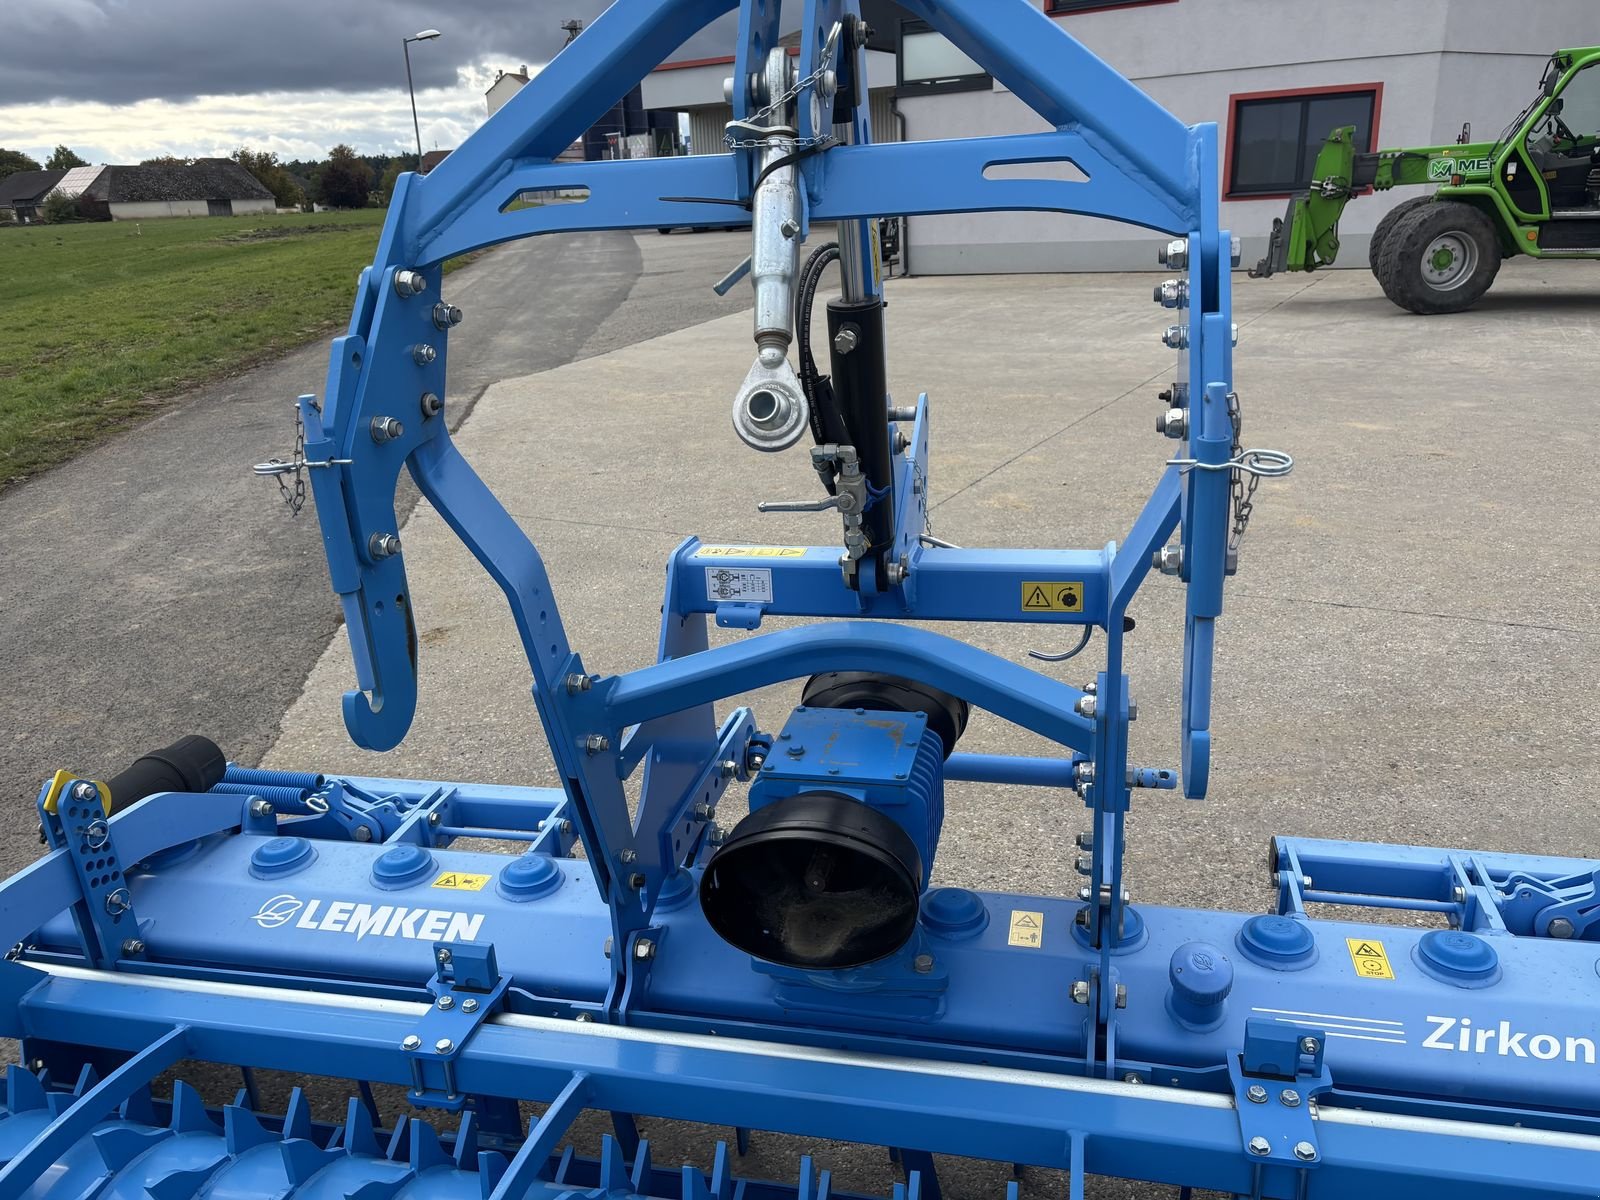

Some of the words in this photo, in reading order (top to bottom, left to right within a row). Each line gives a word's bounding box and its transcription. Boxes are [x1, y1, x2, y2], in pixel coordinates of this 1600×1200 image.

[1459, 159, 1493, 171] ME
[295, 899, 484, 942] LEMKEN
[1422, 1015, 1595, 1064] Zirkon
